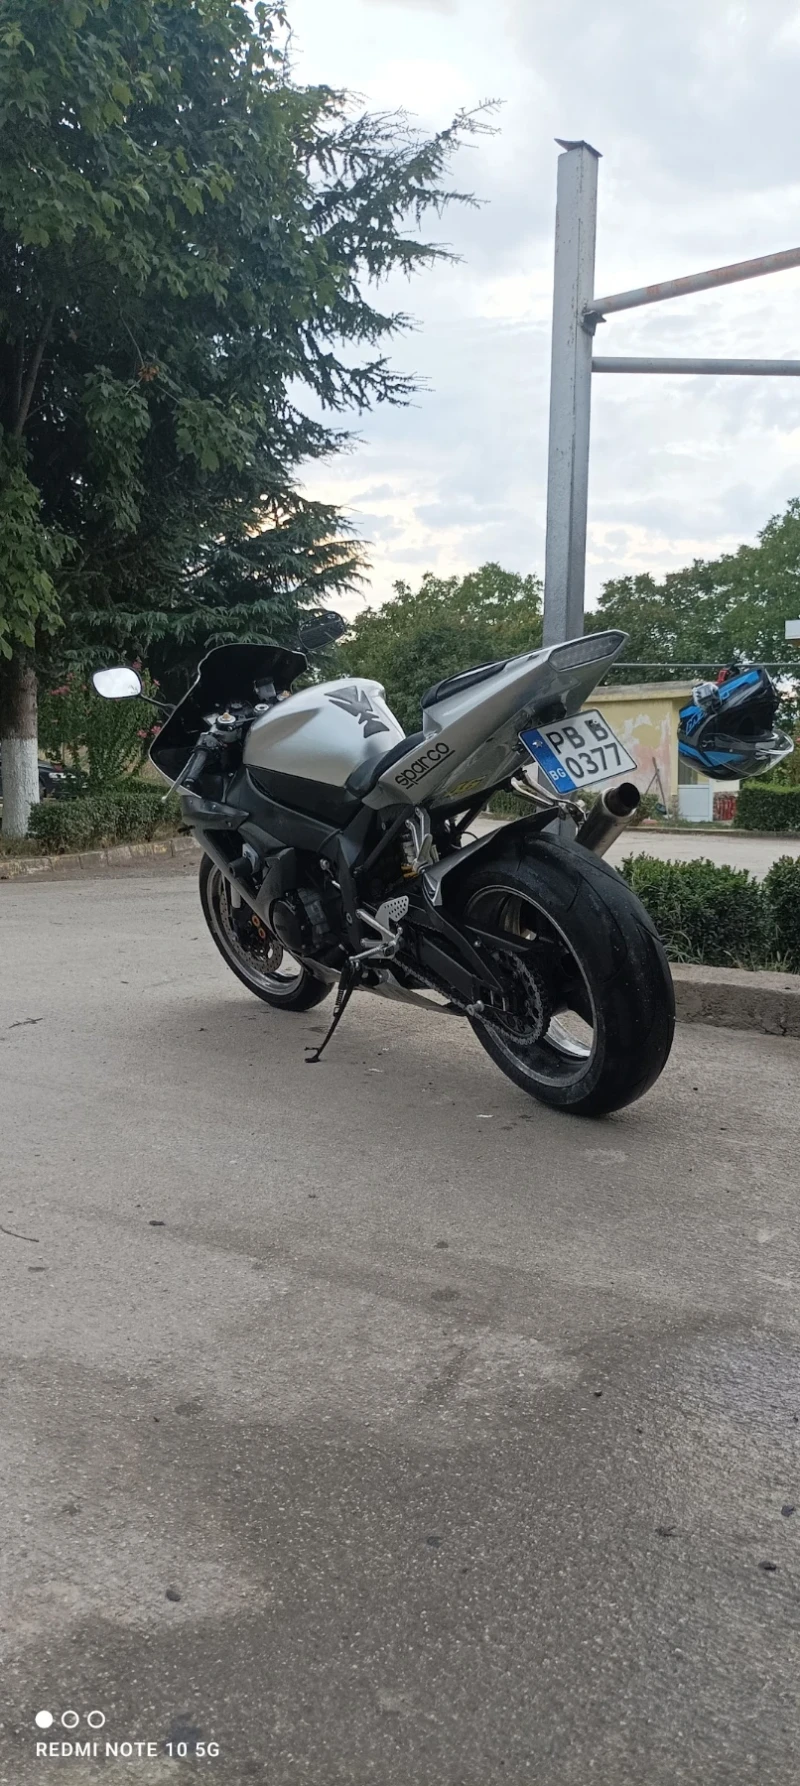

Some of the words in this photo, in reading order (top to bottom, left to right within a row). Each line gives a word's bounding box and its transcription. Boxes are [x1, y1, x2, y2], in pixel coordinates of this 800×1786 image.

[545, 726, 586, 755] PB
[395, 742, 455, 790] sparco
[548, 768, 567, 781] BG
[565, 742, 622, 779] 0377
